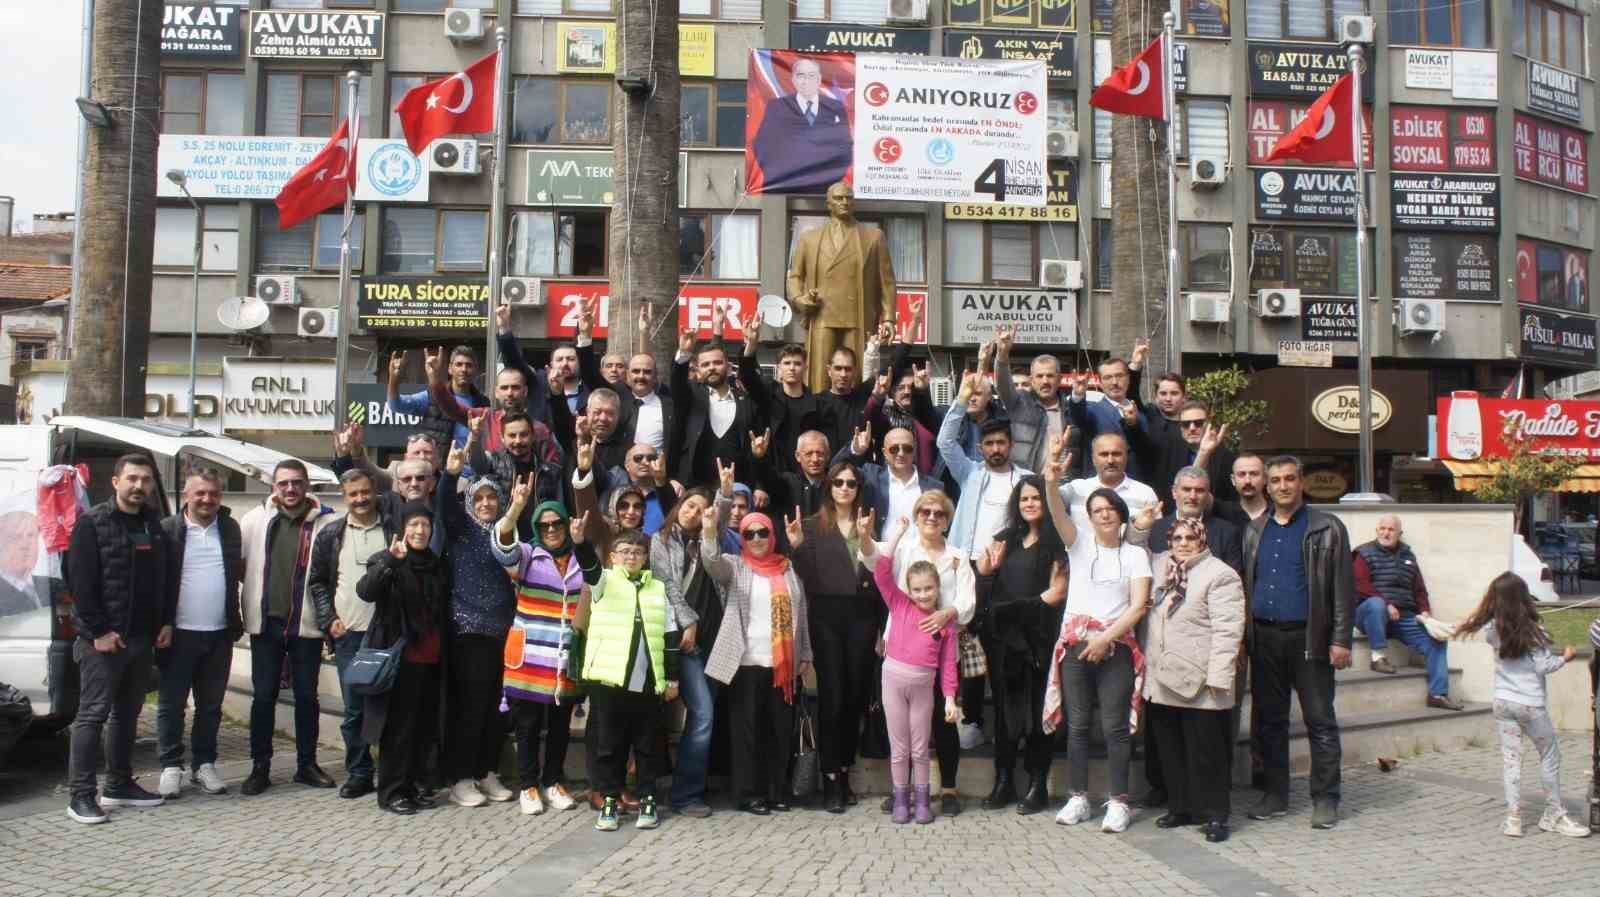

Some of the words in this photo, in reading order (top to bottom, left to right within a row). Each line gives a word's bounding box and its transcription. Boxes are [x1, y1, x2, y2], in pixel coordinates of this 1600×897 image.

[254, 13, 381, 34] AVUKAT
[260, 34, 294, 46] Zehra
[338, 36, 372, 47] KARA
[826, 31, 896, 47] AVUKAT
[994, 40, 1028, 49] AKIN
[1031, 41, 1063, 50] YAPI
[1276, 52, 1348, 69] AVUKAT
[1407, 53, 1449, 66] AVUKAT
[1263, 71, 1305, 82] HASAN
[1531, 63, 1577, 94] AVUKAT
[896, 87, 1012, 110] ANIYORUZ
[981, 119, 993, 127] EN
[1252, 108, 1280, 130] AL
[1392, 115, 1443, 138] E.DİLEK
[1465, 116, 1485, 136] 0530
[945, 127, 982, 136] ARKADA
[204, 141, 215, 150] 25
[218, 142, 245, 151] NOLU
[1515, 121, 1531, 146] AL
[1537, 128, 1560, 154] MAN
[1566, 136, 1582, 160] CA
[193, 155, 226, 167] AKÇAY
[236, 155, 288, 166] ALTINKUM
[1393, 146, 1443, 164] SOYSAL
[1454, 146, 1469, 165] 979
[221, 169, 253, 180] YOLCU
[540, 159, 581, 177] AVA
[1005, 157, 1042, 176] NİSAN
[1515, 148, 1531, 172] TE
[1566, 162, 1585, 186] ME
[974, 158, 1006, 202] 4
[1294, 173, 1357, 192] AVUKA
[1393, 179, 1429, 189] AVUKAT
[1443, 180, 1496, 192] ARABULUCU
[1406, 193, 1448, 204] MEHMET
[952, 205, 962, 216] 0
[967, 206, 993, 217] 534
[998, 207, 1025, 217] 417
[1030, 207, 1048, 217] 88
[1053, 207, 1071, 218] 16
[1463, 206, 1495, 217] YAVUZ
[364, 283, 412, 300] TURA
[416, 279, 490, 301] SİGORTA
[961, 294, 1068, 311] AVUKAT
[977, 312, 1053, 322] ARABULUCU
[1280, 341, 1302, 351] FOTO
[1562, 331, 1595, 350] EMLAK
[251, 375, 306, 394] ANLI
[225, 398, 336, 417] KUYUMCULUK
[1499, 405, 1580, 441] Nadide
